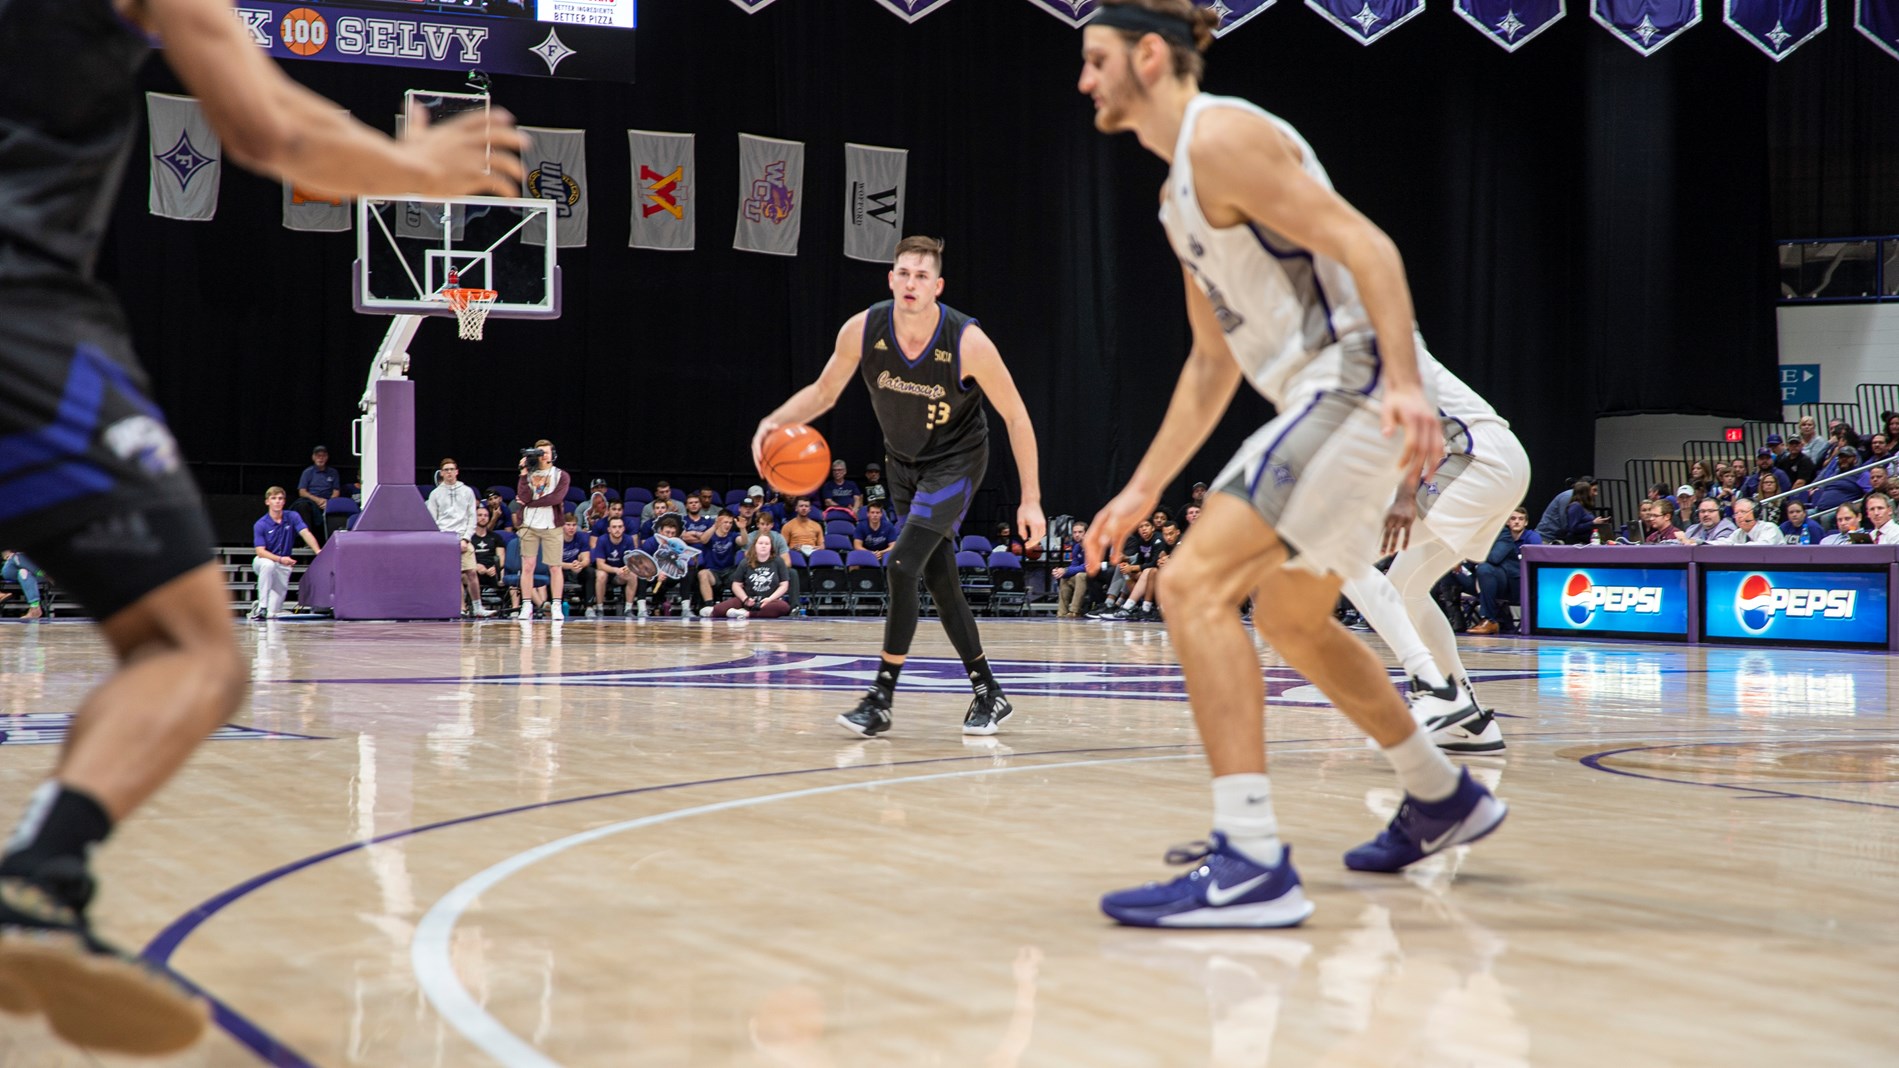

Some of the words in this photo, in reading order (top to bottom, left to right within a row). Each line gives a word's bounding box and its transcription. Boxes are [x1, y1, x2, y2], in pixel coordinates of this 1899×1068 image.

[554, 12, 586, 22] BETTER
[576, 6, 614, 15] INGREDIENTS
[282, 18, 326, 45] 100
[336, 16, 489, 64] SELVY
[744, 161, 785, 223] WCU
[856, 182, 865, 226] WOFFORD
[866, 185, 897, 229] W
[1780, 369, 1799, 384] E
[1781, 387, 1797, 400] F
[1588, 586, 1664, 615] PEPSI
[1767, 588, 1857, 619] PEPSI
